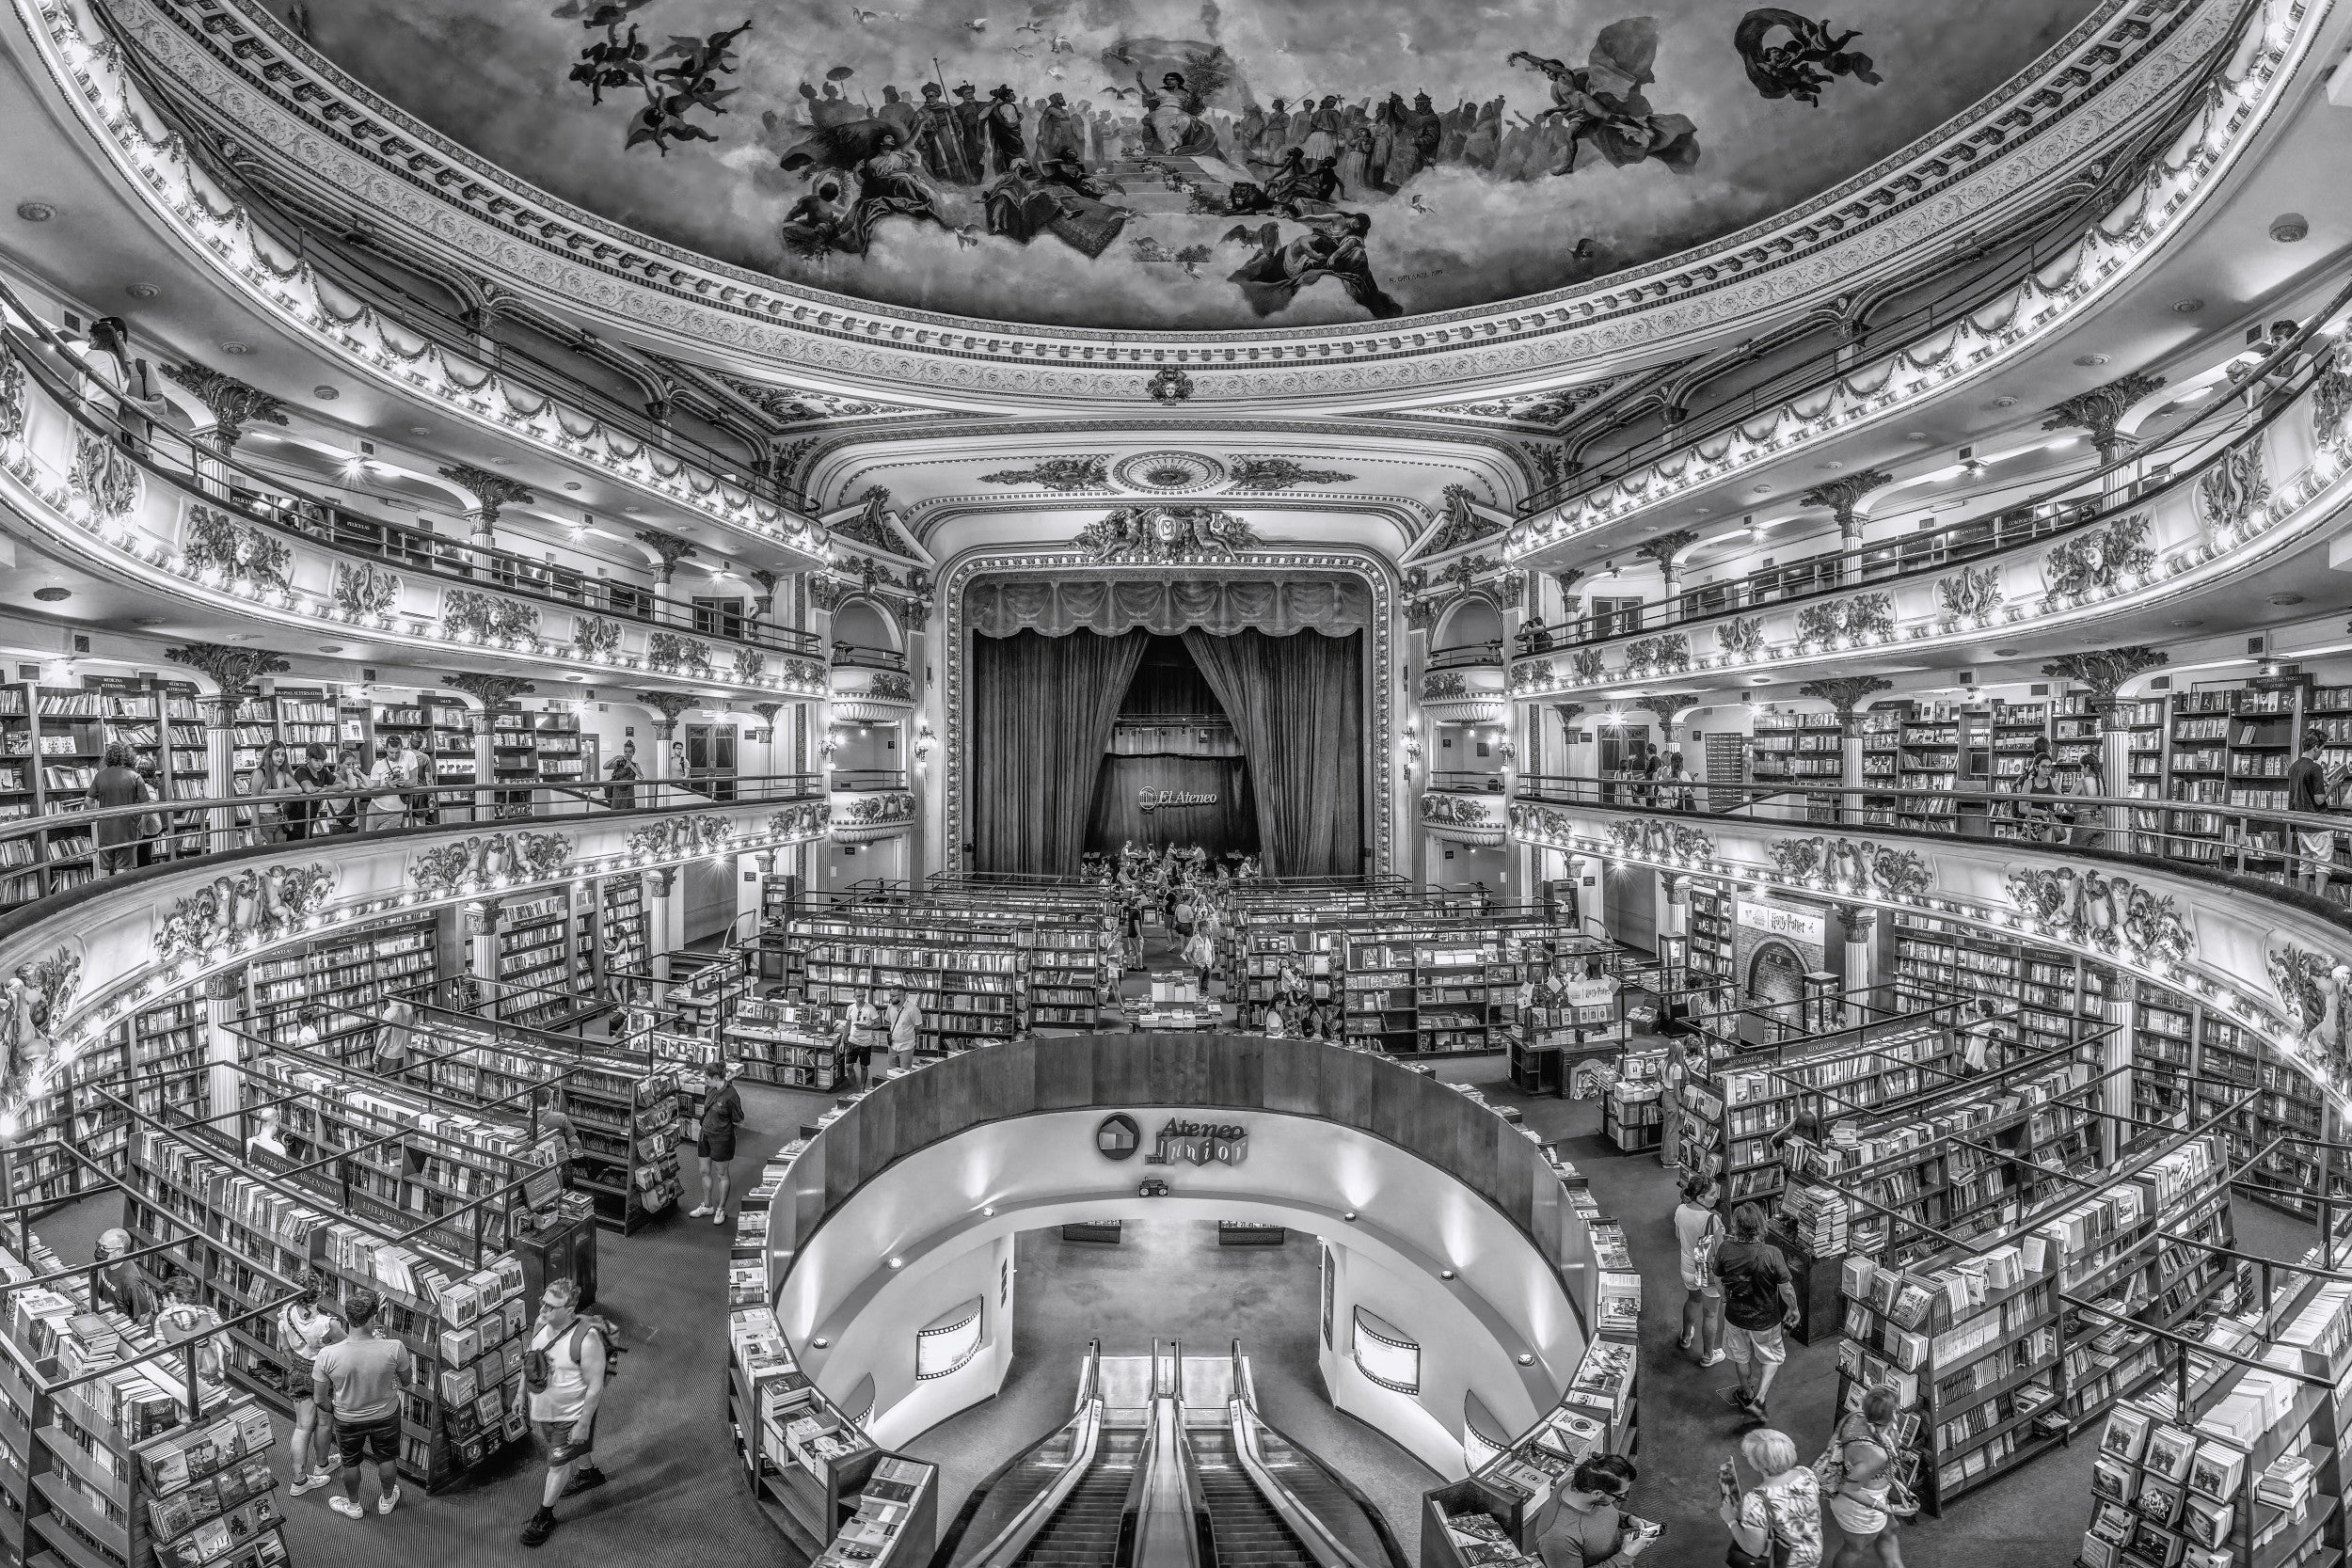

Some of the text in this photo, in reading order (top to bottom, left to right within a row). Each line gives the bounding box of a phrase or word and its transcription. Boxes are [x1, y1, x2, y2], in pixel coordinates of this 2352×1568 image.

[1157, 789, 1217, 804] El Ateneo
[1770, 912, 1787, 930] Harry
[1788, 913, 1805, 933] Potter
[1162, 1117, 1245, 1139] Ateneo
[203, 1129, 236, 1151] ARGENTINA
[1156, 1139, 1247, 1162] Junior
[298, 1172, 338, 1196] ARGENTINA
[362, 1201, 410, 1228] LITERATURA
